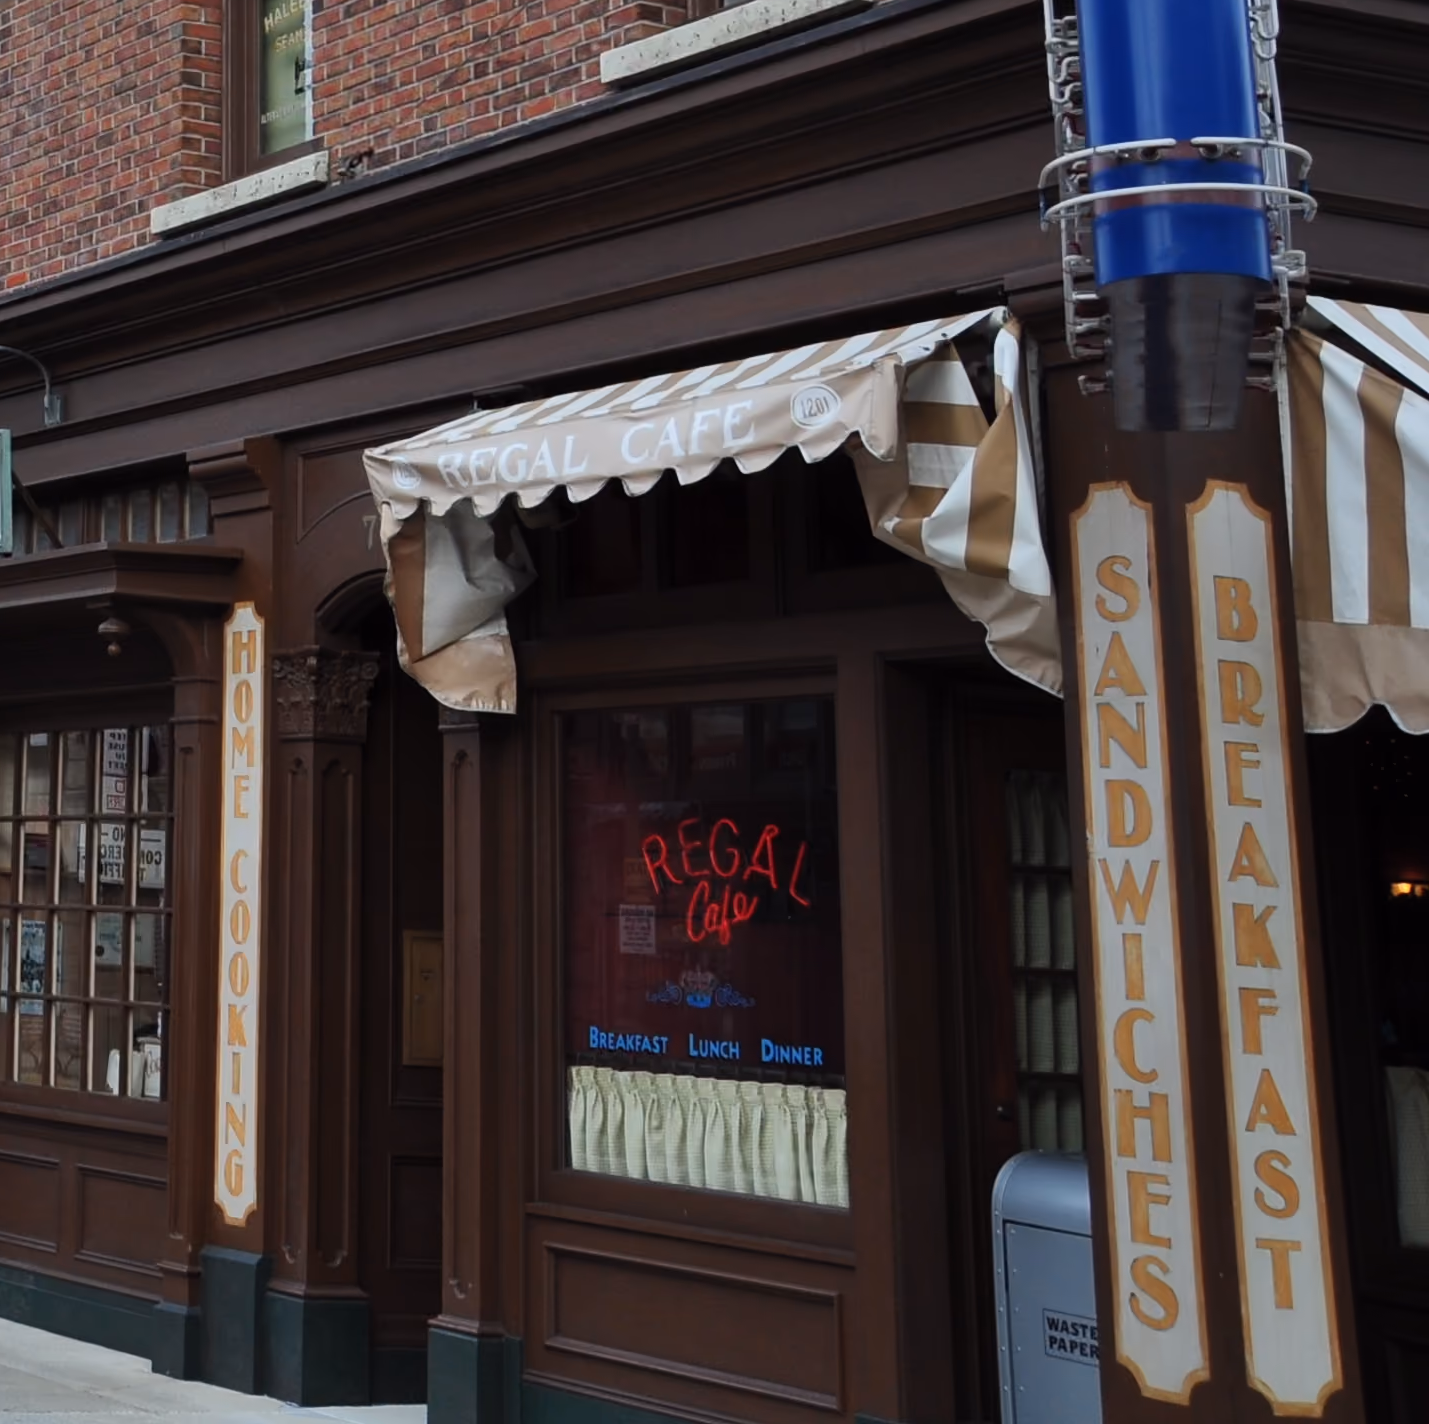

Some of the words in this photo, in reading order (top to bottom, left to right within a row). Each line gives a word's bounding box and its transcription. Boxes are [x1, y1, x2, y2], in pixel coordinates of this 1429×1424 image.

[436, 433, 589, 490] REGAL
[621, 399, 754, 465] CAFE
[231, 630, 256, 819] HOME
[642, 818, 810, 907] REGAL
[687, 880, 759, 946] Cafe
[1094, 555, 1180, 1331] SANDWICHES
[1213, 575, 1301, 1311] BREAKFAST
[224, 848, 253, 1197] COOKING
[590, 1026, 669, 1054] BREAKFAST
[689, 1033, 740, 1060] LUNCH
[761, 1038, 823, 1066] DINNER
[1046, 1316, 1098, 1341] WASTE
[1048, 1335, 1100, 1360] PAPER
